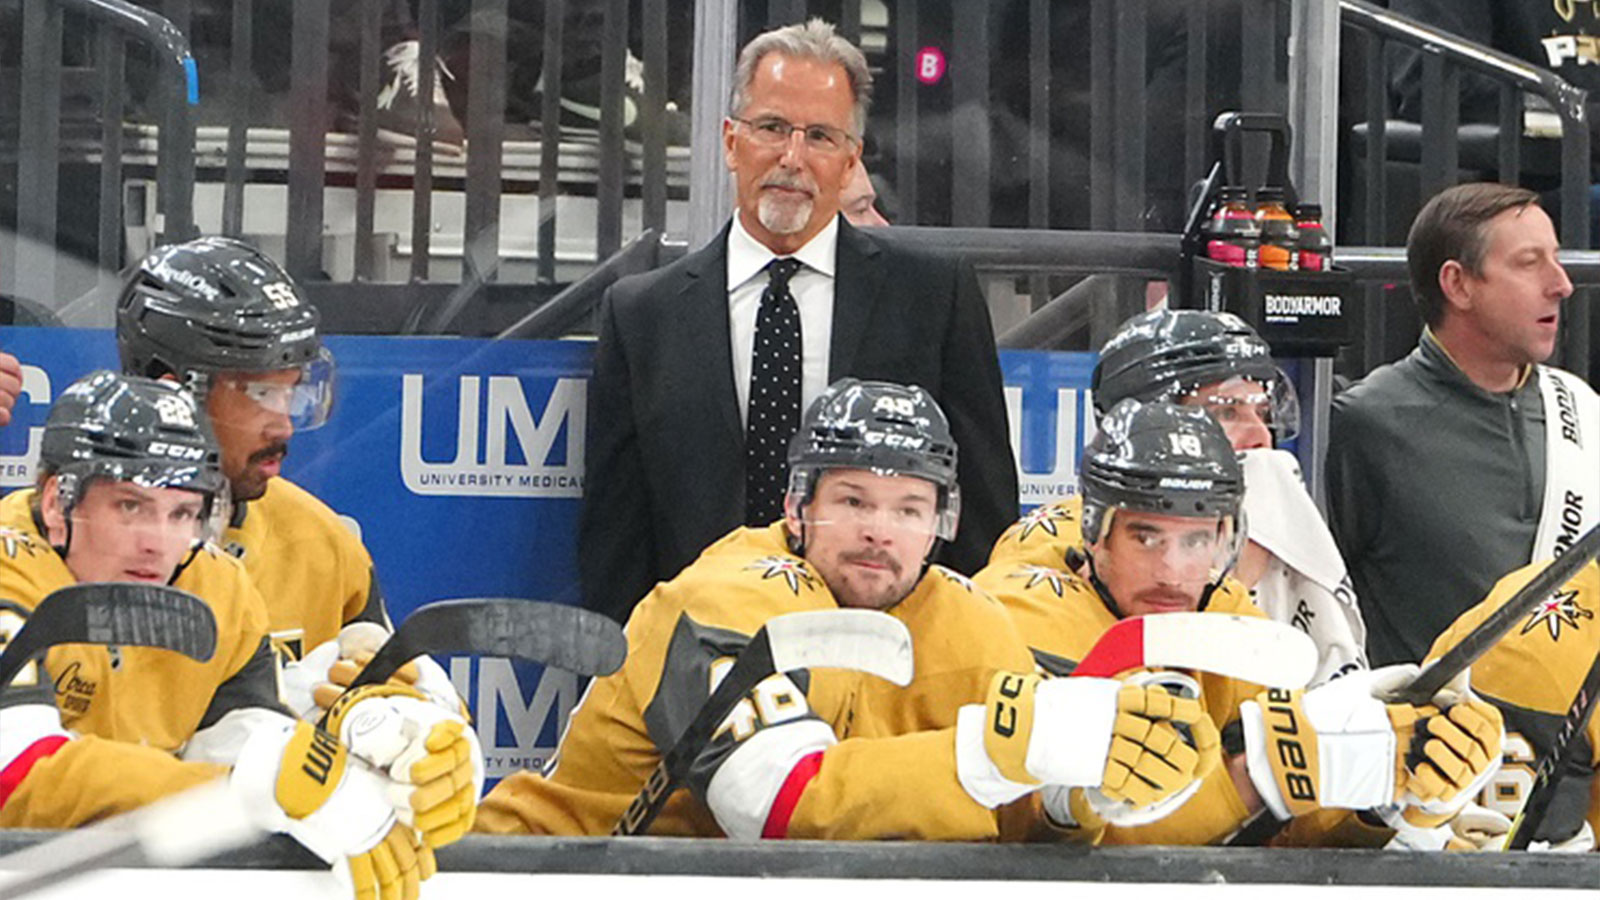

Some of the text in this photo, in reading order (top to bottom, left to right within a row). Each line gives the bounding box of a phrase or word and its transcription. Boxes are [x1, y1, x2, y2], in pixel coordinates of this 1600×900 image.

[921, 53, 938, 78] B
[262, 282, 299, 310] 55
[1265, 295, 1342, 316] BODYARMOR
[401, 374, 588, 468] UM
[148, 441, 204, 460] CCM
[864, 432, 925, 449] CCM
[419, 474, 514, 486] UNIVERSITY
[1160, 477, 1213, 490] BAUER
[1267, 686, 1317, 802] Baue
